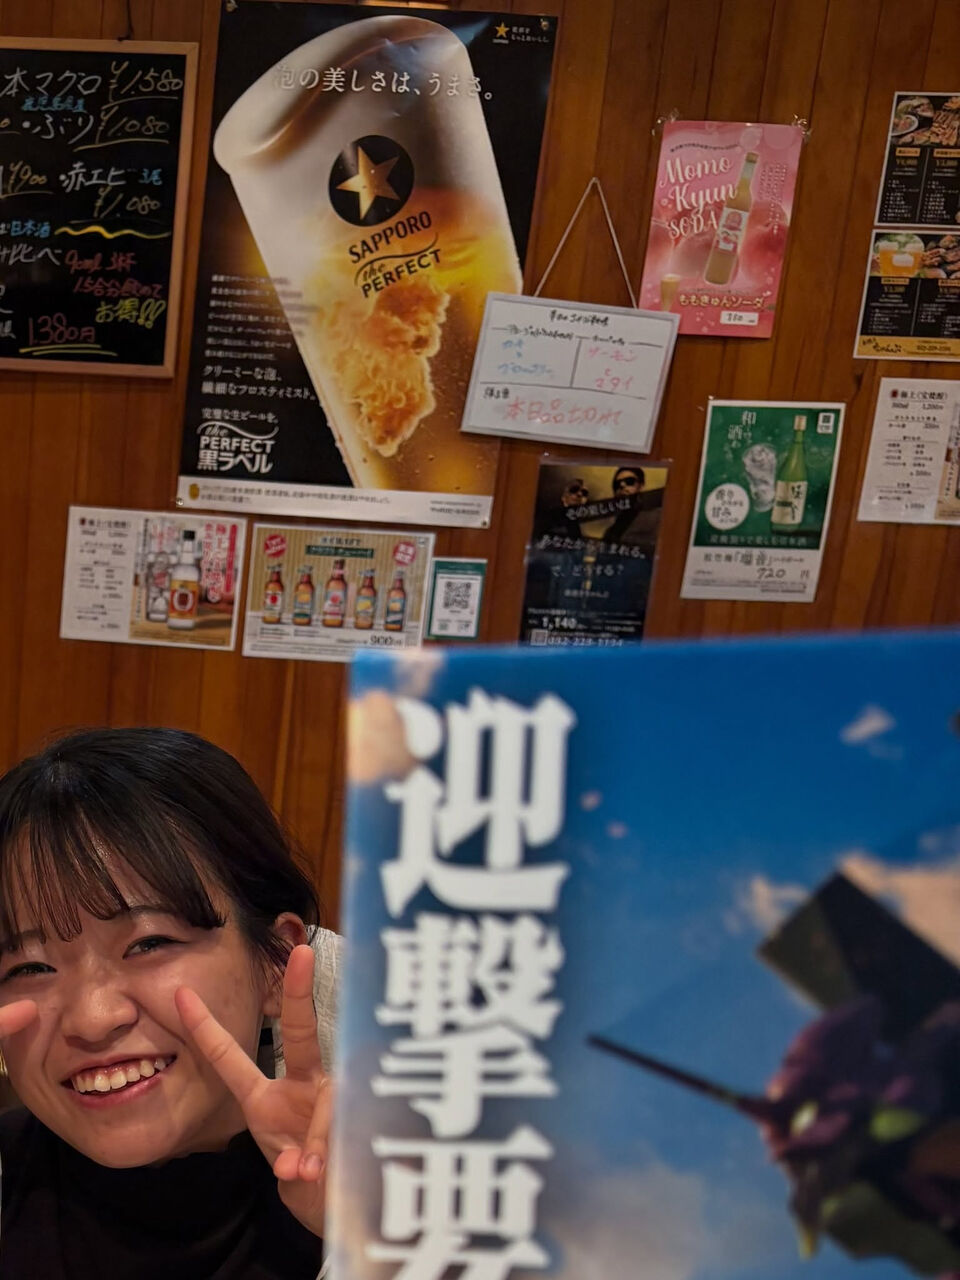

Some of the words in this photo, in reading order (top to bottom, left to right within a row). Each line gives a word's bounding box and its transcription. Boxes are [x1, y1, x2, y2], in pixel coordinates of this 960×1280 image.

[659, 155, 733, 188] Momo
[669, 183, 738, 217] Kyun
[347, 210, 433, 264] SAPPORO
[668, 211, 718, 240] SODA
[360, 248, 442, 298] PERFECT
[200, 435, 276, 454] PERFECT
[197, 449, 273, 474] 黒ラベル
